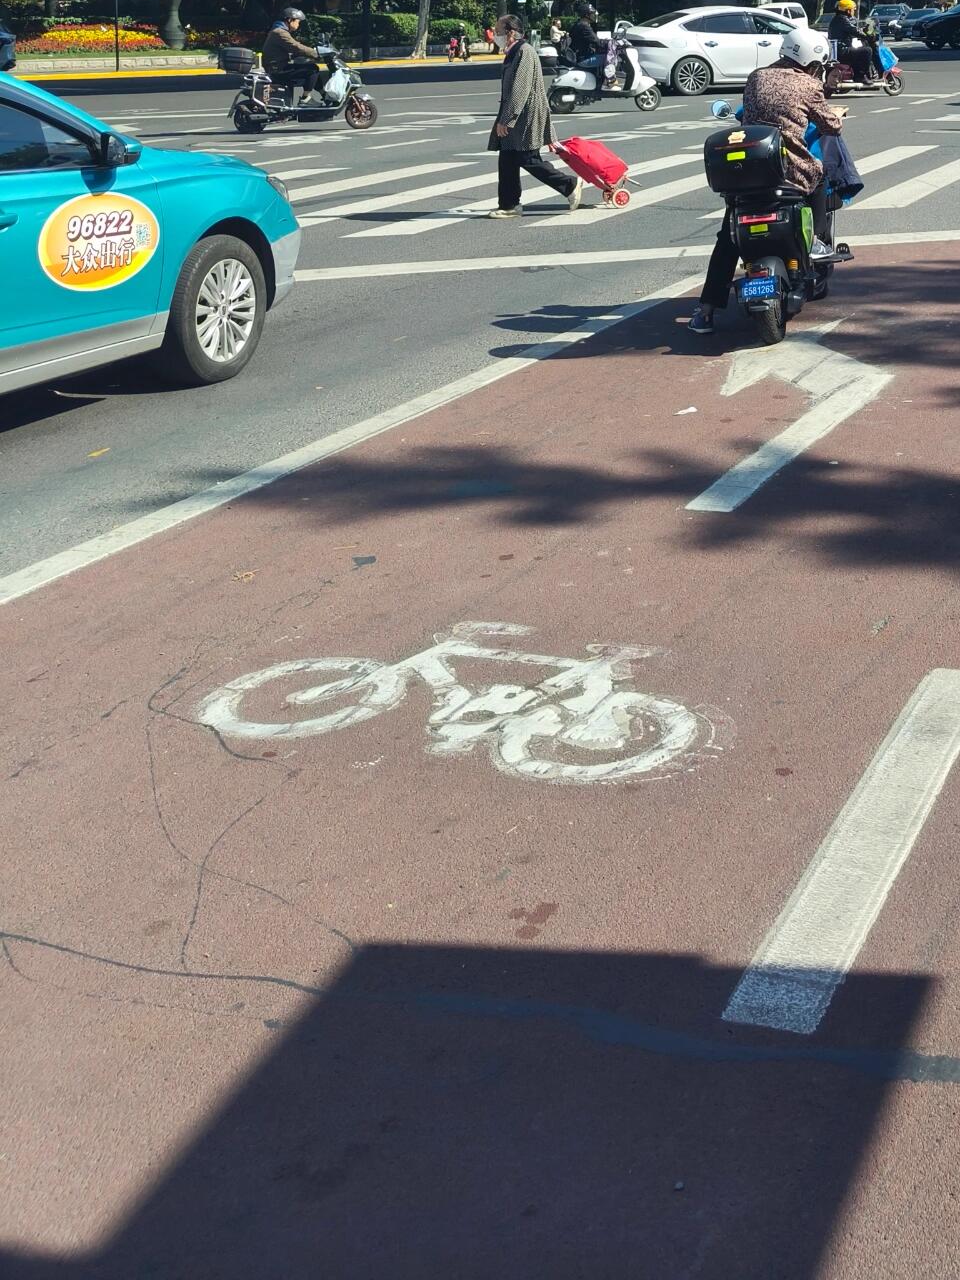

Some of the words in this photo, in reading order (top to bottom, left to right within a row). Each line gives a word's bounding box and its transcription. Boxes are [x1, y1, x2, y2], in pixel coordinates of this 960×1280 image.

[67, 210, 133, 242] 96822
[61, 238, 135, 277] 大众出行
[744, 284, 775, 296] E581263
